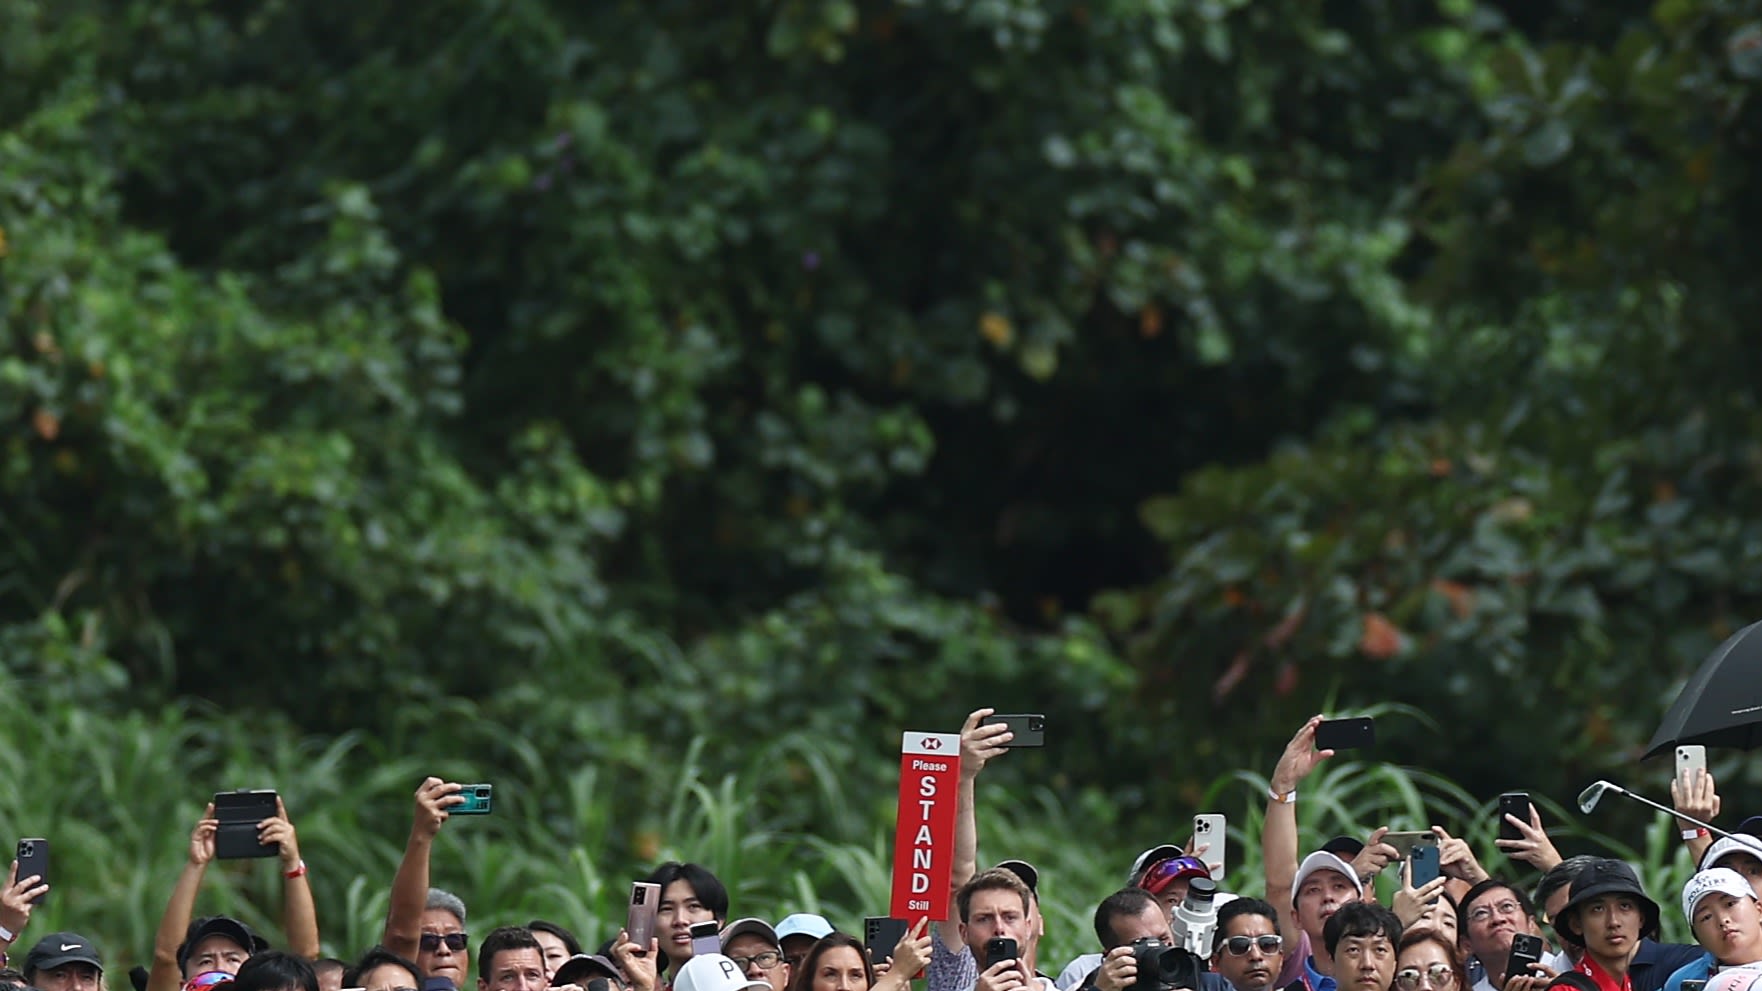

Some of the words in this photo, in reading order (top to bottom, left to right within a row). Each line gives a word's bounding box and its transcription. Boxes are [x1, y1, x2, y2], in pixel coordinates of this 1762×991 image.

[912, 759, 948, 772] Please
[911, 776, 937, 894] STAND
[908, 900, 930, 911] Still
[719, 960, 734, 980] P
